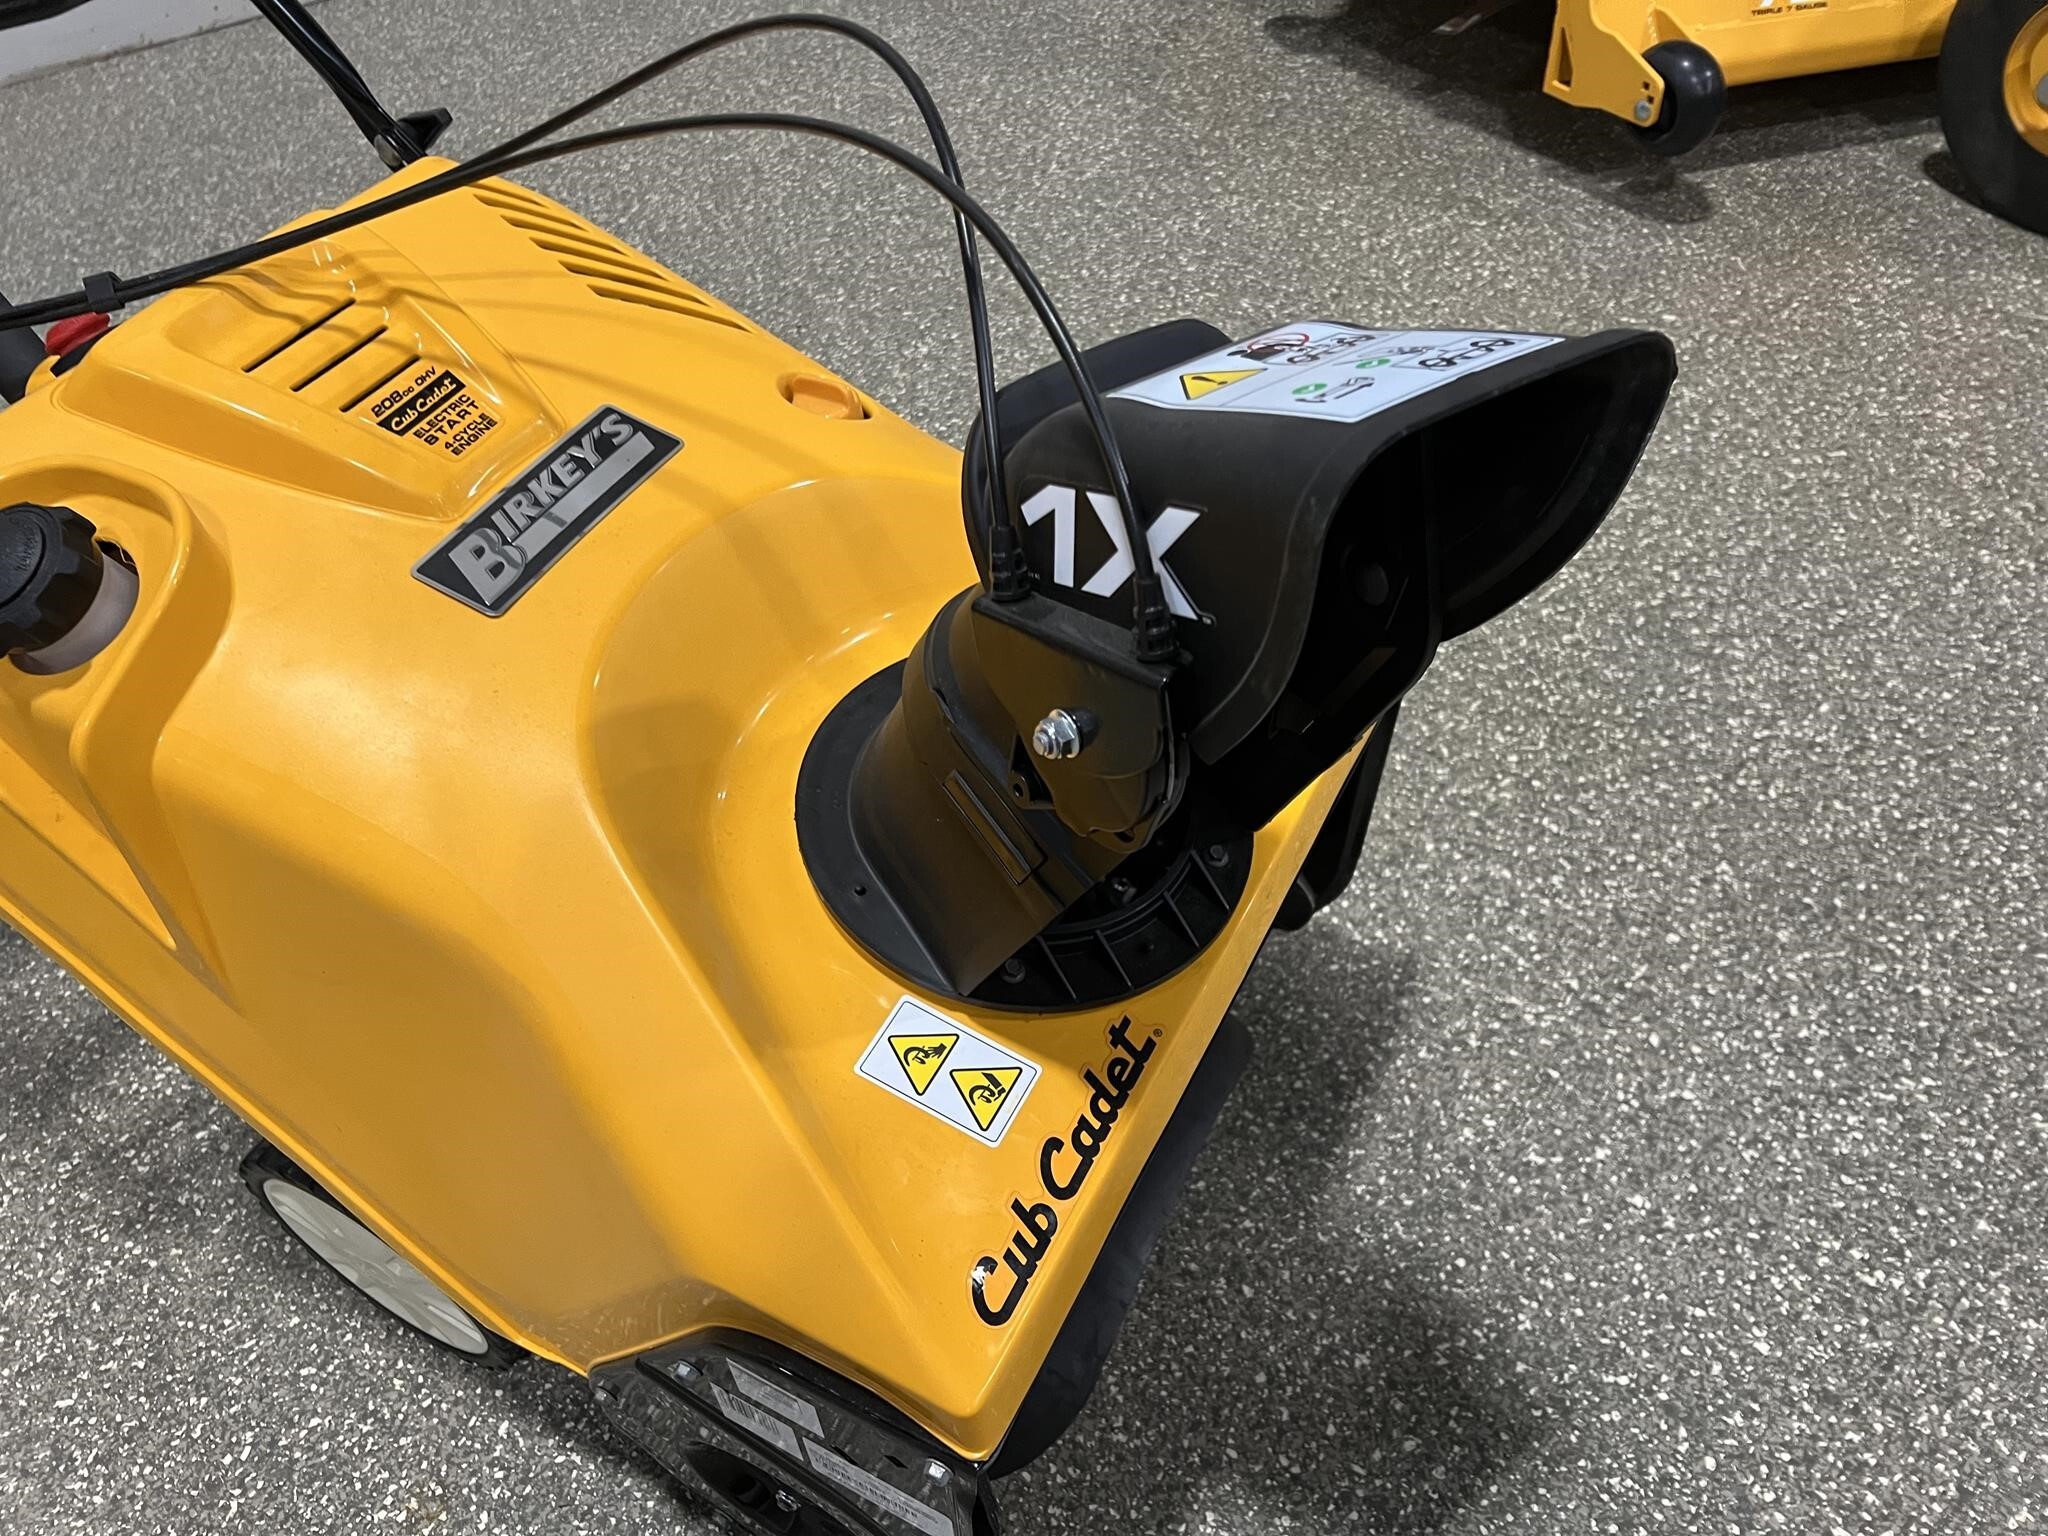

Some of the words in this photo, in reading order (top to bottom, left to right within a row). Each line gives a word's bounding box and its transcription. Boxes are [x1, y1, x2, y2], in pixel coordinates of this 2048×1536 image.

[415, 366, 436, 387] OHV
[391, 408, 419, 431] Cub
[416, 378, 457, 412] Cadet
[412, 394, 471, 439] ELECTRIC
[423, 400, 479, 446] START
[444, 412, 490, 450] 4-CYCLE
[450, 416, 498, 456] ENGINE
[448, 412, 634, 607] BIRKEY'S
[1020, 484, 1201, 621] 1X
[971, 1197, 1058, 1327] Cub
[1040, 1015, 1158, 1201] Cadet
